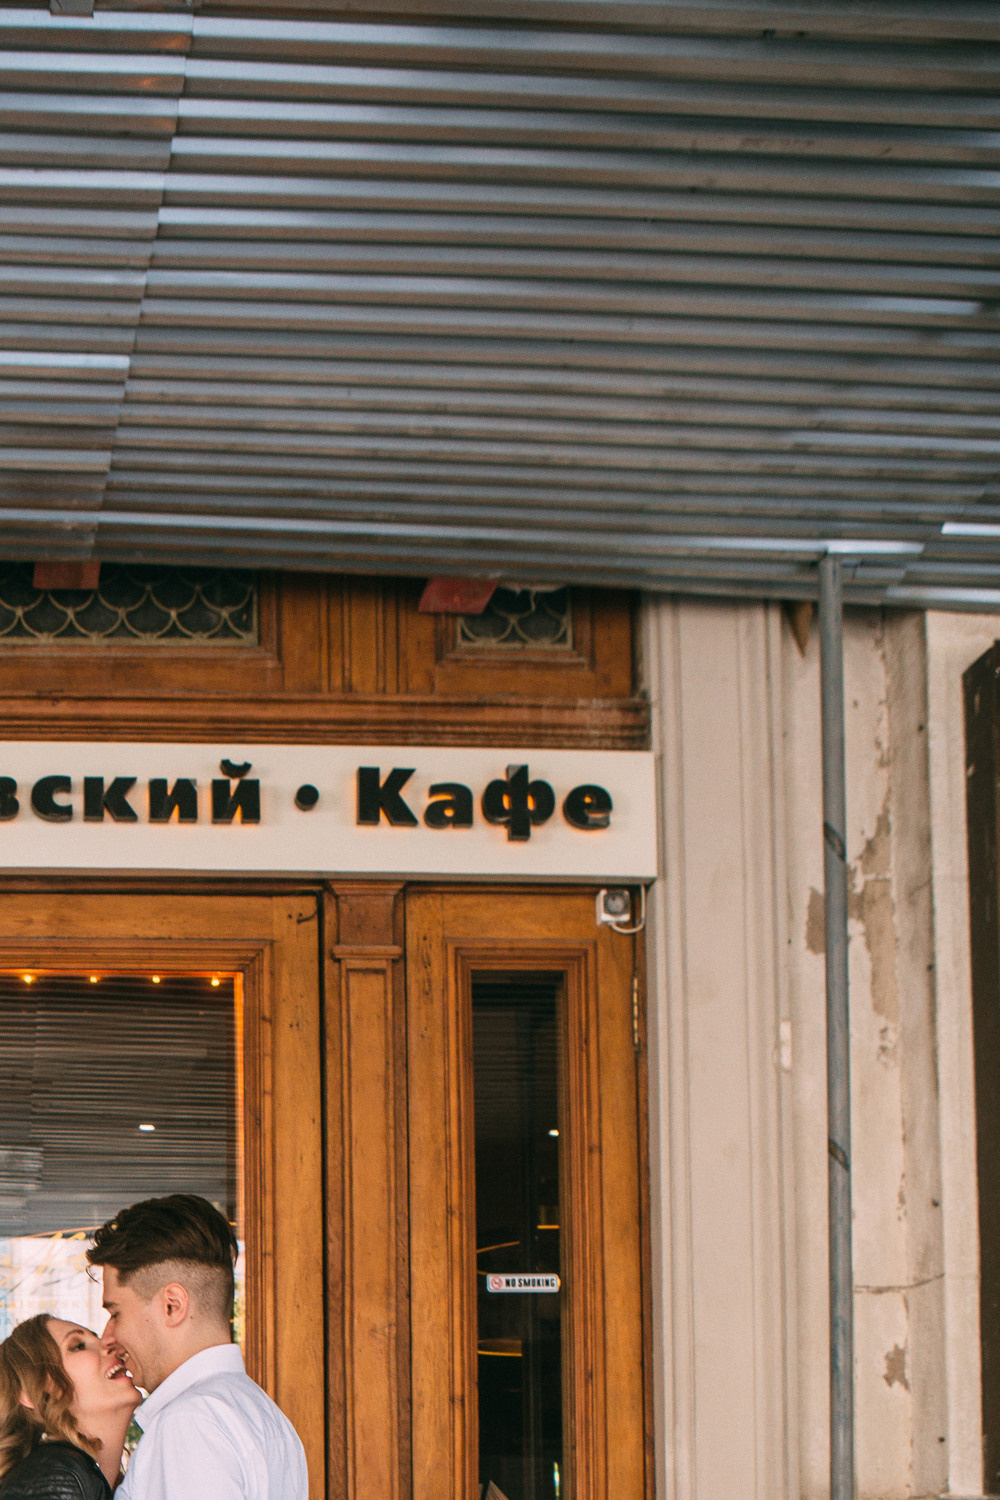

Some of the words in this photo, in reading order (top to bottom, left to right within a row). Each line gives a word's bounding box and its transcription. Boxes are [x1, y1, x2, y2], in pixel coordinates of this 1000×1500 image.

[355, 764, 614, 841] Кафе
[505, 1278, 516, 1287] NO
[518, 1278, 555, 1287] SMOKING
